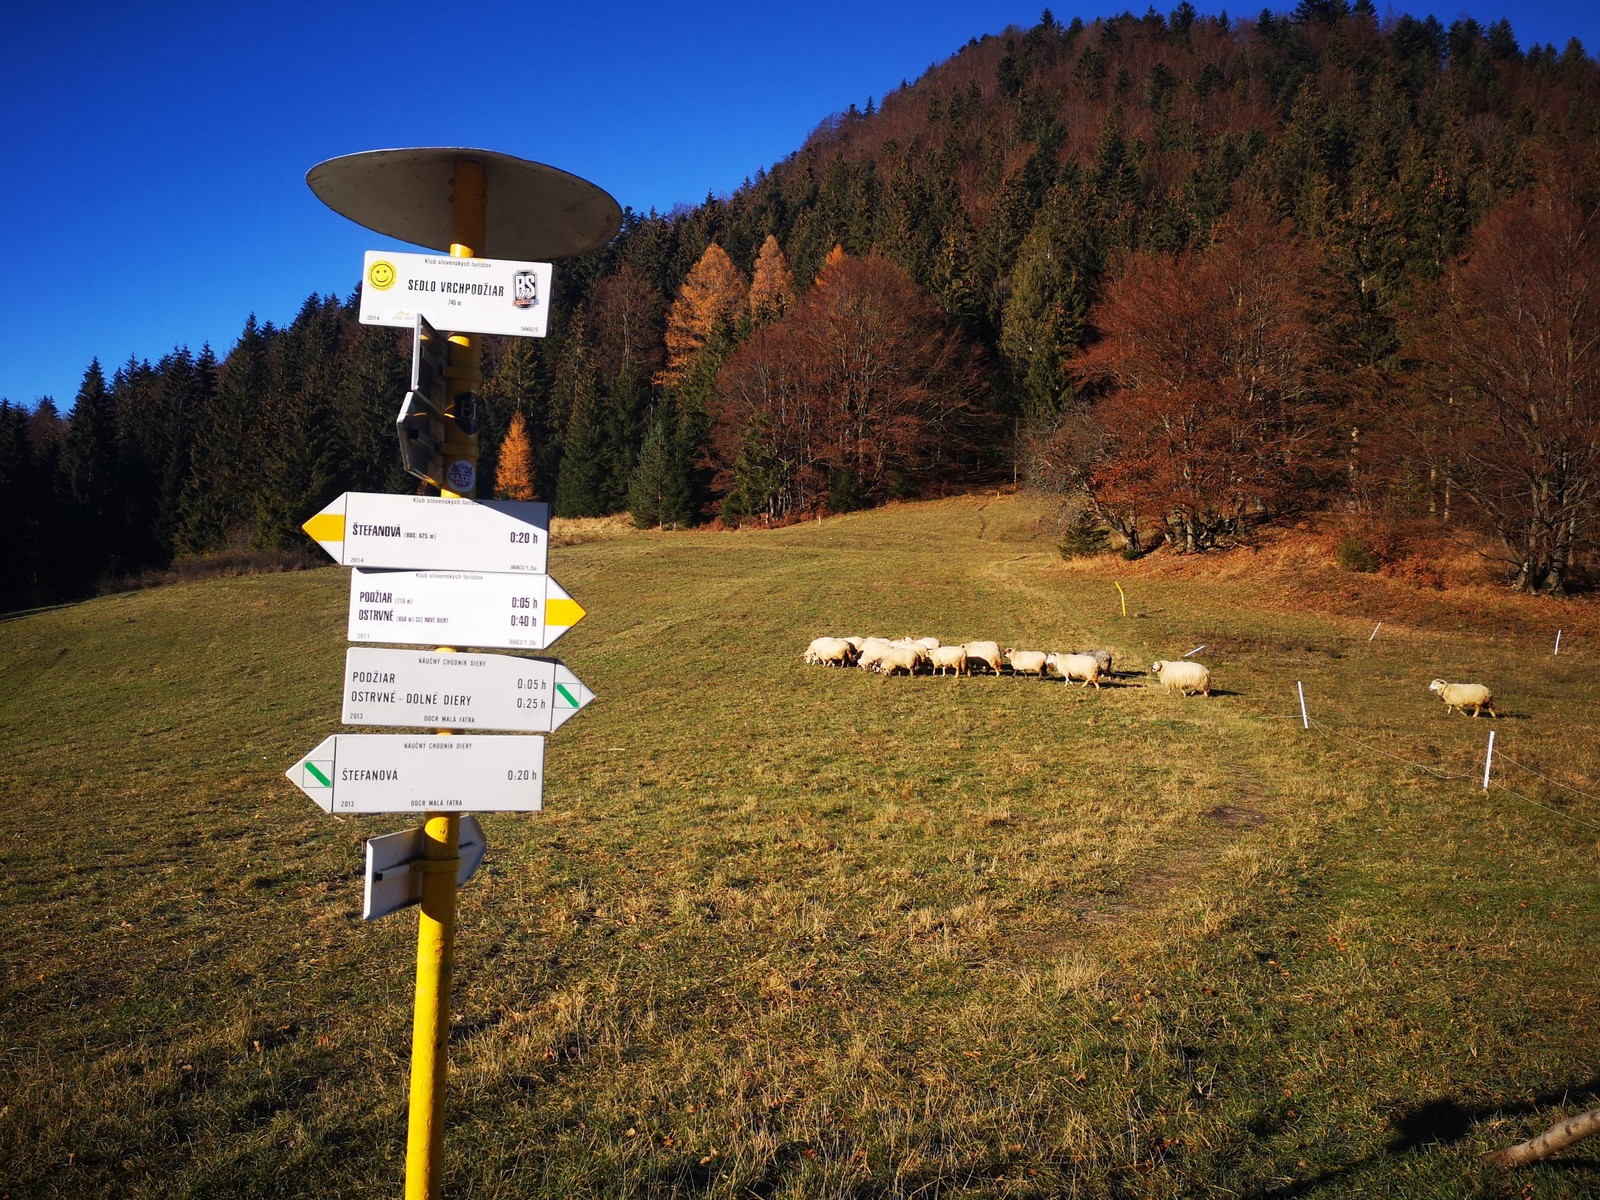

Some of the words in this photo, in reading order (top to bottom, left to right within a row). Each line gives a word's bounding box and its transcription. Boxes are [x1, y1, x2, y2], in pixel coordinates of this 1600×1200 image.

[438, 259, 470, 268] slovenských
[408, 279, 436, 292] SEDLO
[440, 281, 504, 297] VRCHPODŽIAR
[427, 498, 461, 507] slovenských
[352, 522, 401, 537] ŠTEFANOVÁ
[510, 531, 530, 544] 0:20
[532, 533, 538, 544] h
[429, 573, 461, 581] slovenských
[359, 590, 392, 604] PODŽIAR
[511, 596, 530, 609] 0:05
[532, 597, 537, 609] h
[359, 607, 393, 622] OSTRVNÉ
[510, 614, 530, 627] 0:40
[531, 616, 536, 627] h
[443, 658, 467, 666] CHODNÍK
[352, 670, 395, 684] PODŽIAR
[517, 678, 539, 690] 0:05
[541, 680, 546, 690] h
[351, 690, 396, 703] OSTRVNÉ
[406, 692, 438, 705] DOLNÉ
[443, 694, 472, 706] DIERY
[516, 698, 538, 709] 0:25
[540, 699, 546, 709] h
[441, 715, 457, 723] MALÁ
[456, 742, 472, 750] DIERY
[342, 768, 398, 781] ŠTEFANOVÁ
[507, 770, 529, 780] 0:20
[531, 770, 537, 780] h
[428, 798, 444, 806] MALÁ
